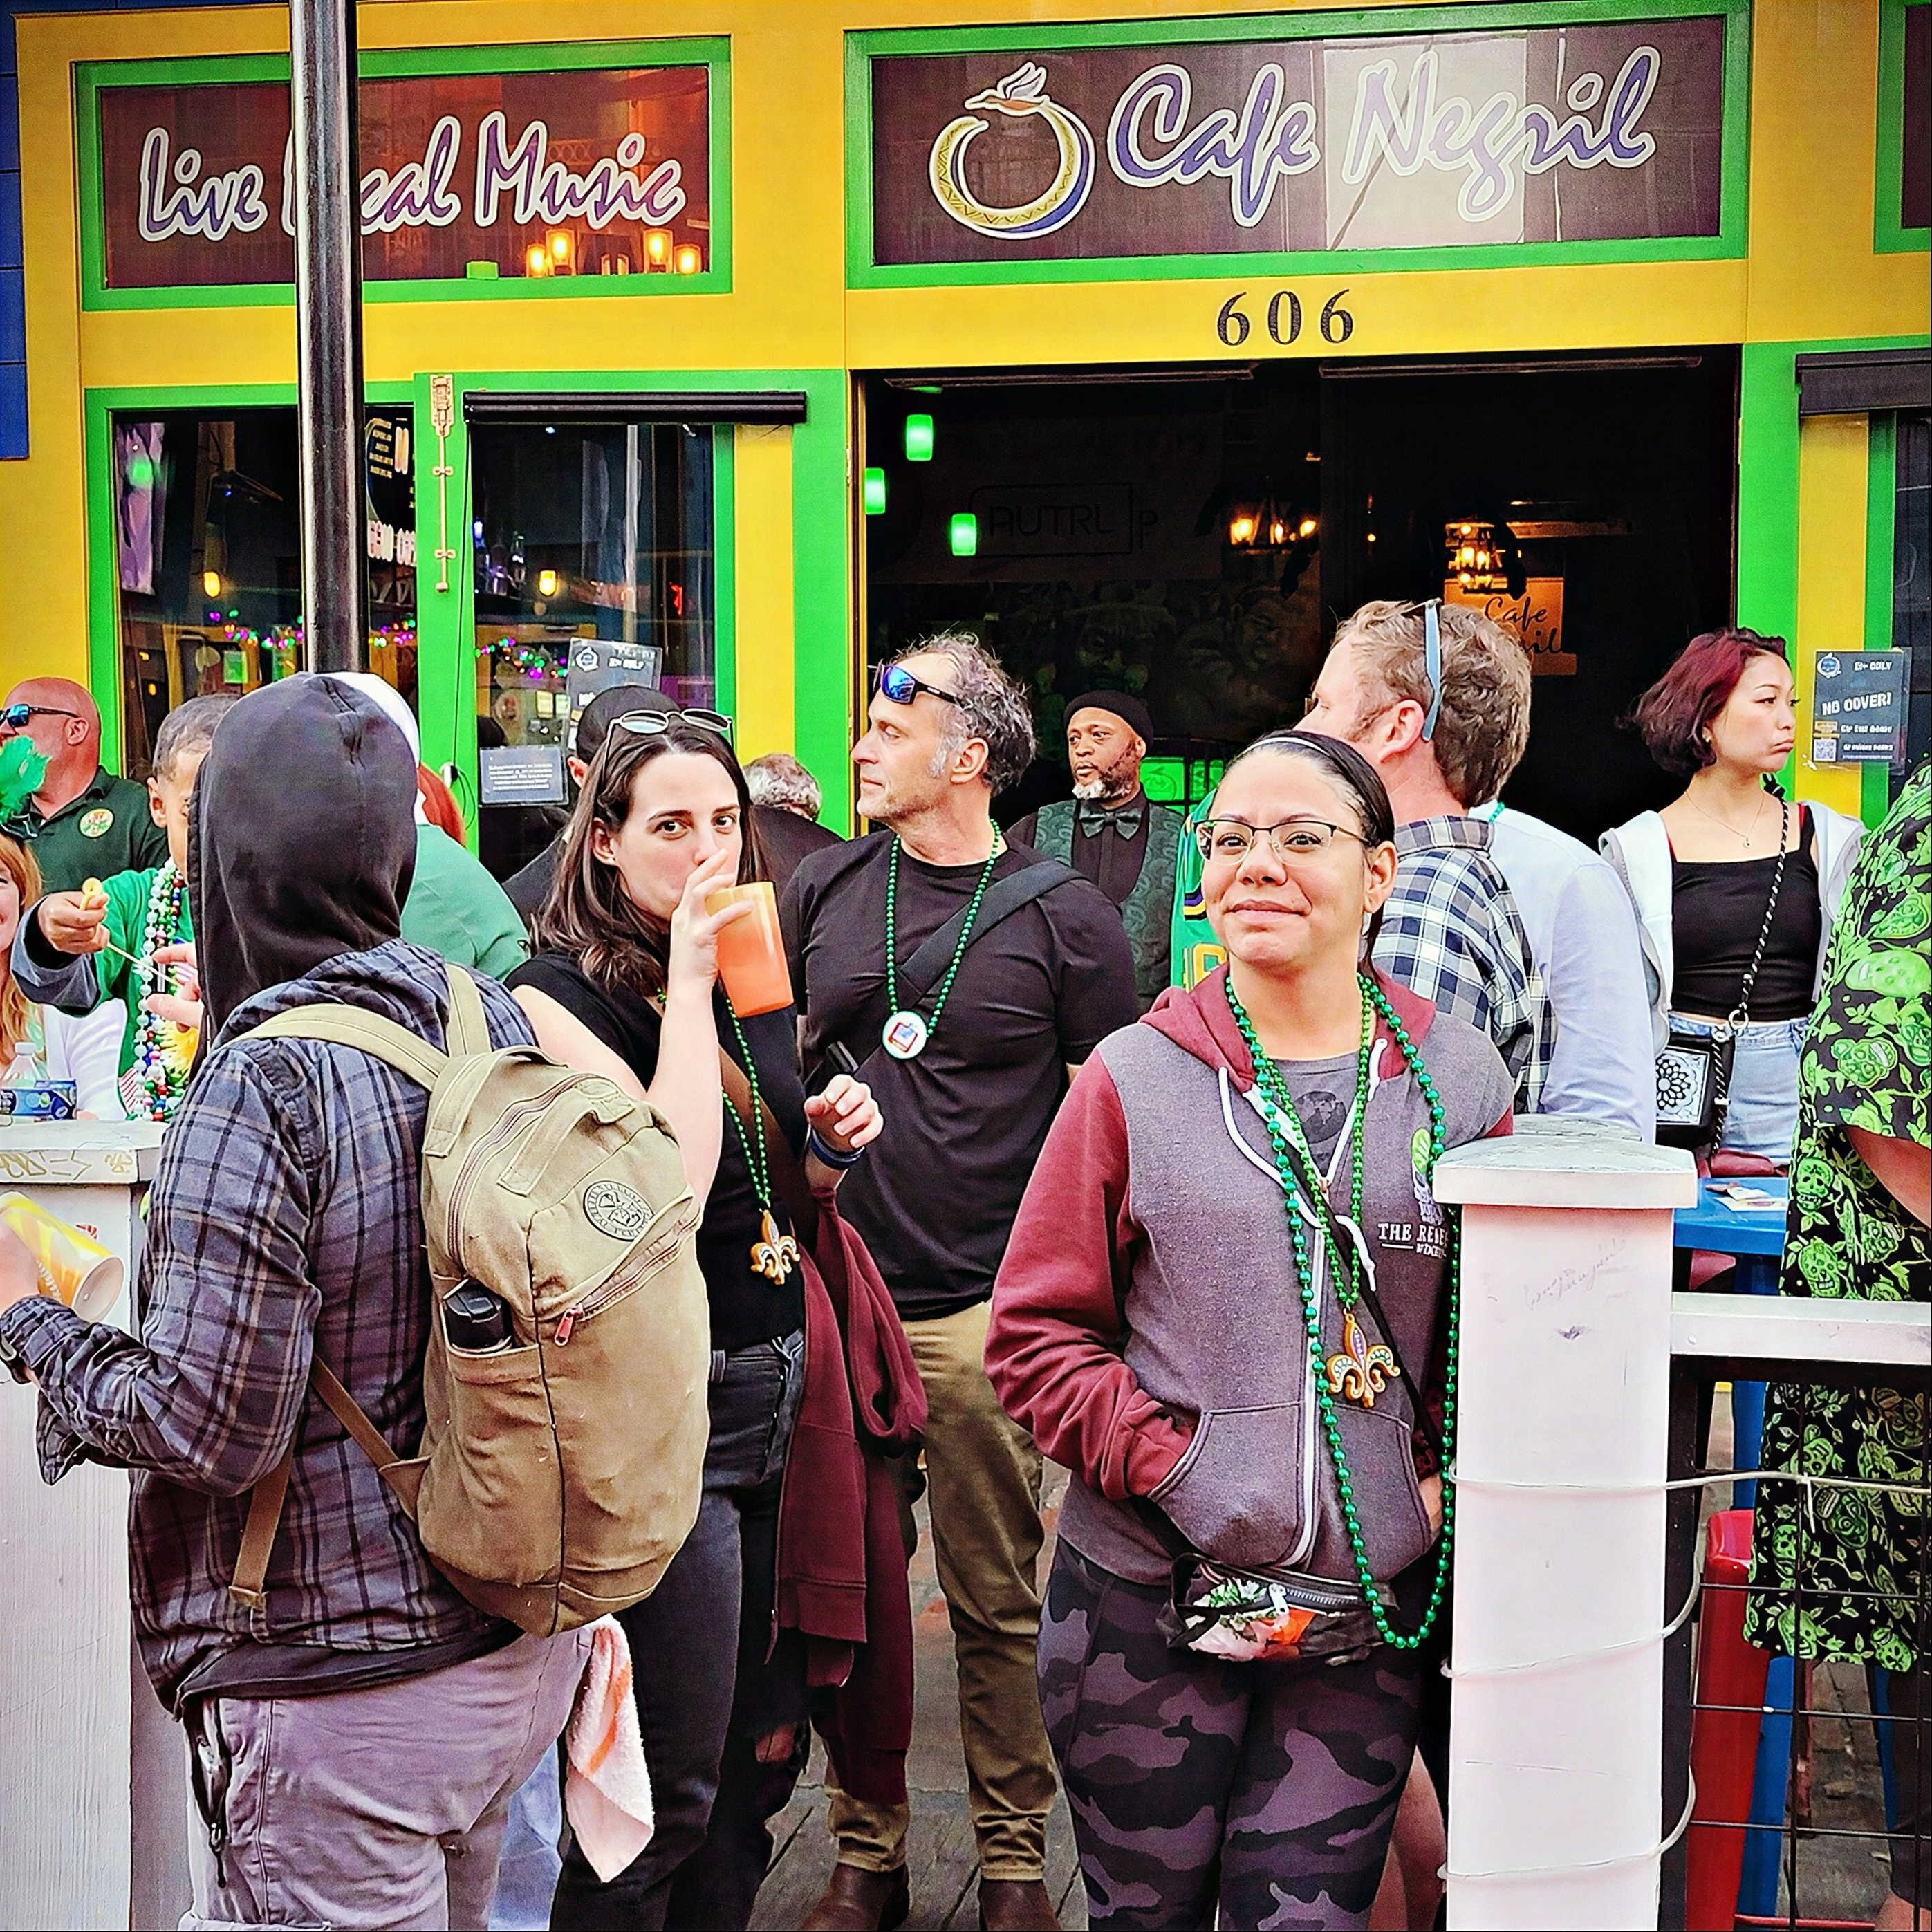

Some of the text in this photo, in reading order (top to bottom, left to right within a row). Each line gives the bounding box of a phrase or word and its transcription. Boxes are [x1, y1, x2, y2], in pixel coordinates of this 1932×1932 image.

[1106, 46, 1661, 227] Cafe Negril
[140, 127, 268, 241] Live
[474, 111, 686, 230] Music
[1217, 288, 1355, 346] 606
[1485, 596, 1548, 632] Cafe
[1377, 1223, 1412, 1241] THE
